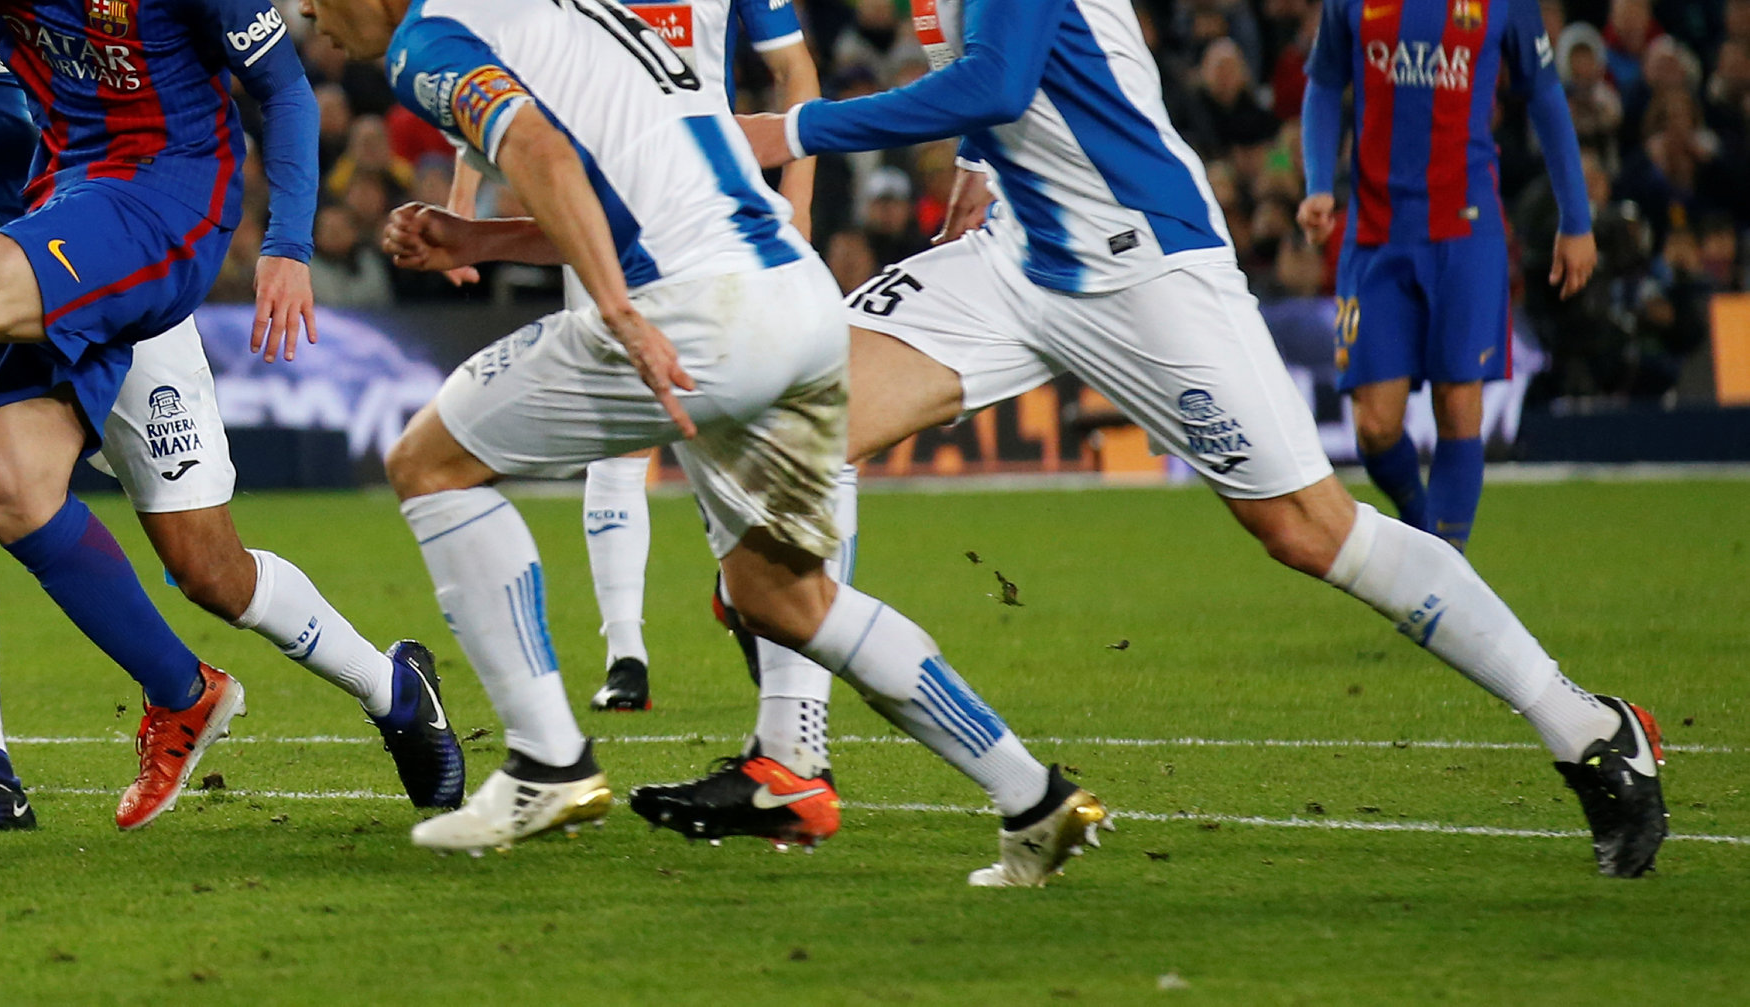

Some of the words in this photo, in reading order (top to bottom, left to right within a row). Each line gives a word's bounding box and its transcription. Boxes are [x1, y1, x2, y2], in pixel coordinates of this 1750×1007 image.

[226, 6, 283, 51] beko
[41, 52, 141, 91] AIRWAYS
[1367, 39, 1471, 73] QATAR
[848, 267, 924, 317] 15
[145, 417, 198, 439] RIVIERA
[149, 432, 204, 459] MAYA
